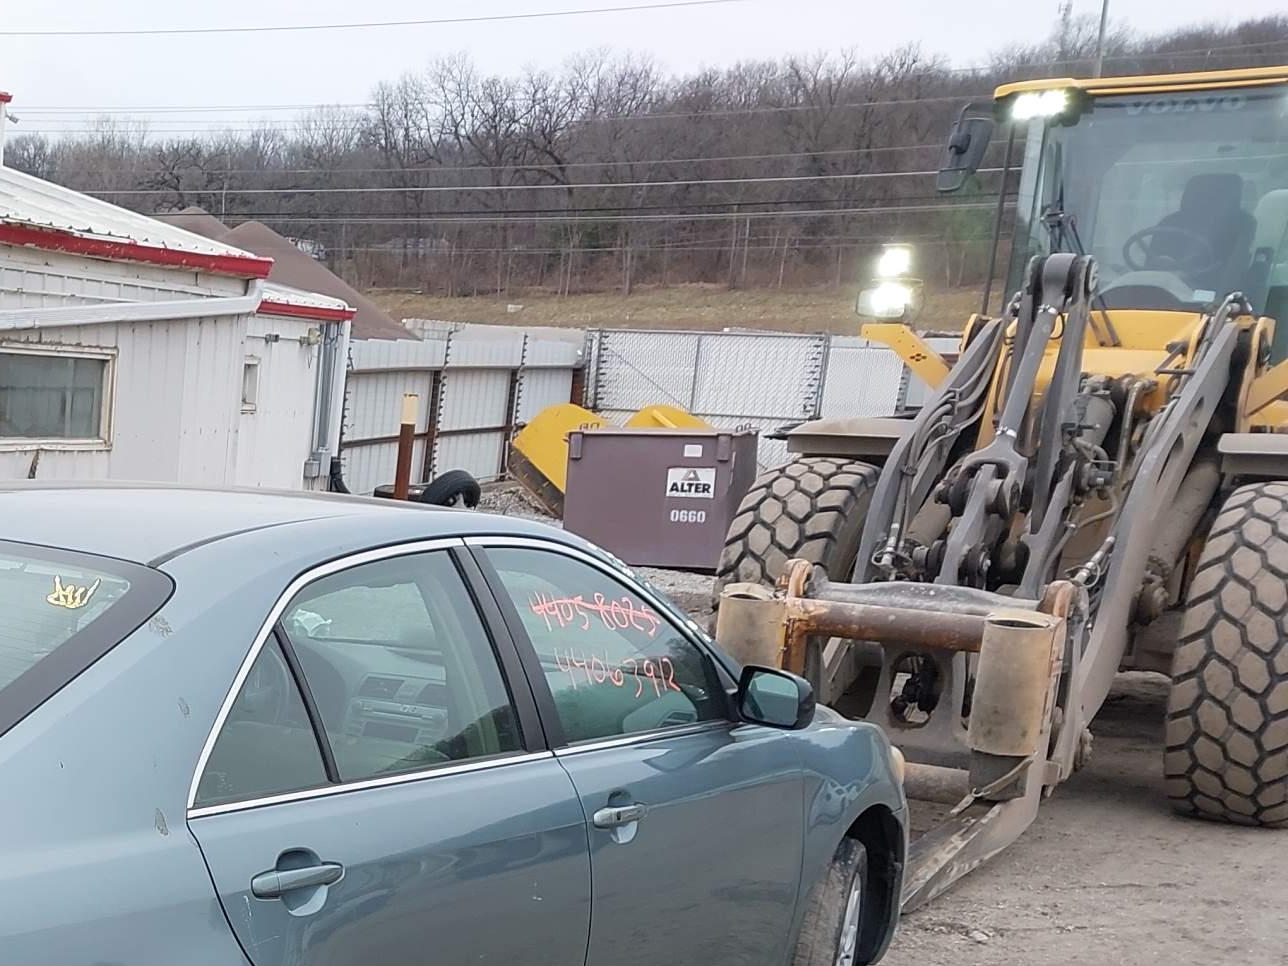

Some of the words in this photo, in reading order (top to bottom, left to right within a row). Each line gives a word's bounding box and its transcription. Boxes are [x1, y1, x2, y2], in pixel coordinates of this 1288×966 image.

[1125, 96, 1247, 116] VOLVO
[669, 481, 712, 495] ALTER
[670, 509, 706, 524] 0660
[553, 647, 680, 698] 44063912
